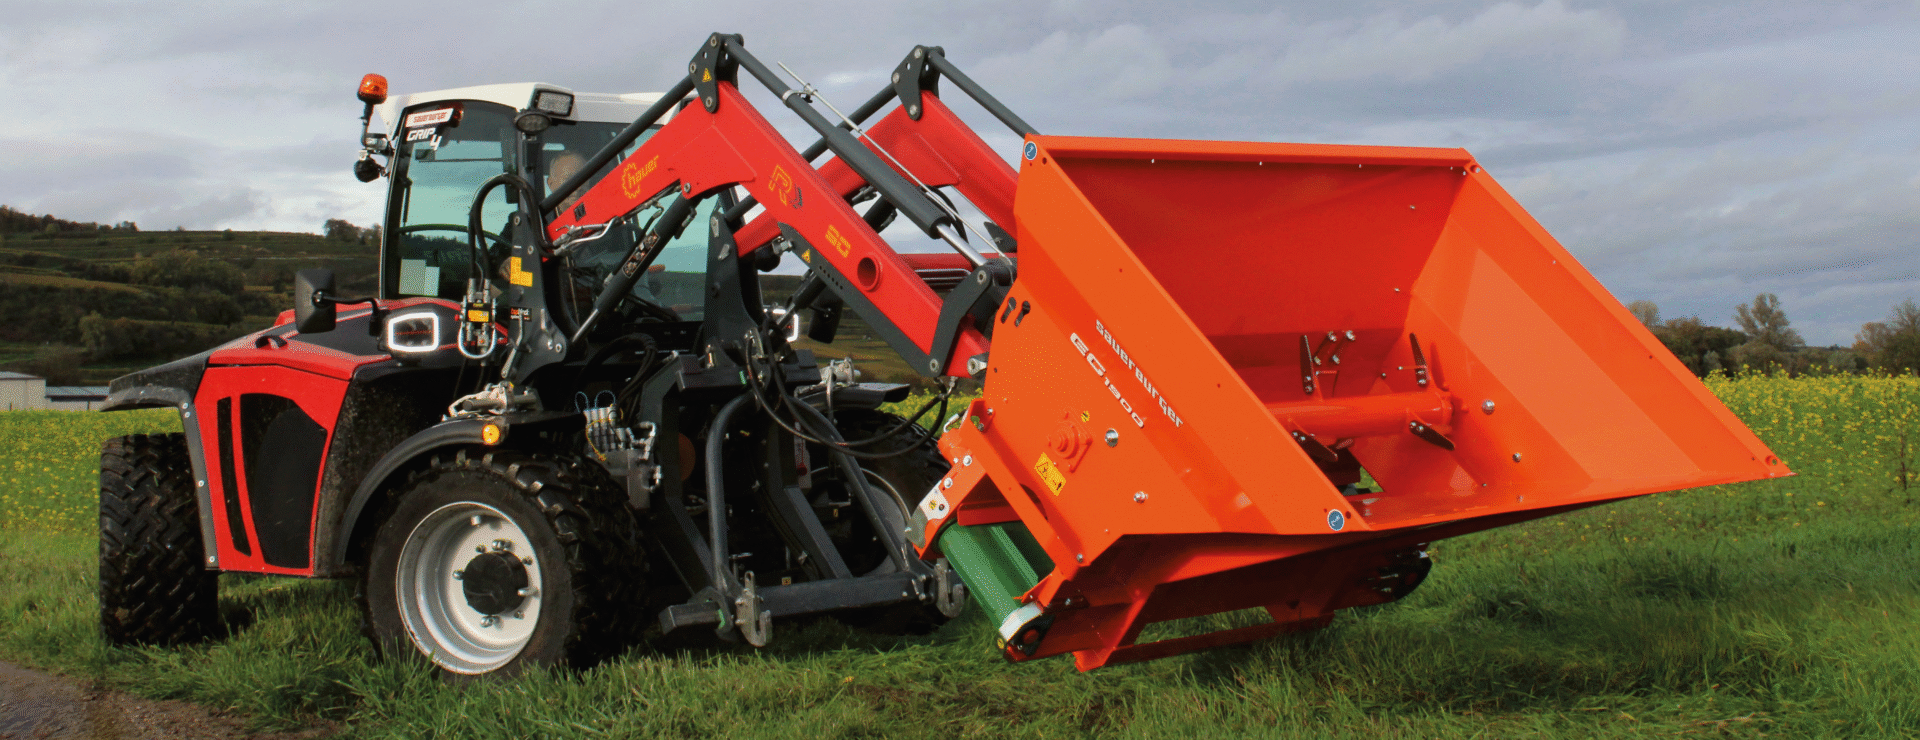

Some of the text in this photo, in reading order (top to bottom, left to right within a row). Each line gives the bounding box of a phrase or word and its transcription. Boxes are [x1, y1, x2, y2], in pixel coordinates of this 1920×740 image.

[406, 127, 436, 142] GRIP
[430, 133, 443, 151] 4
[628, 154, 659, 189] hauer
[1096, 319, 1184, 427] sauerburger
